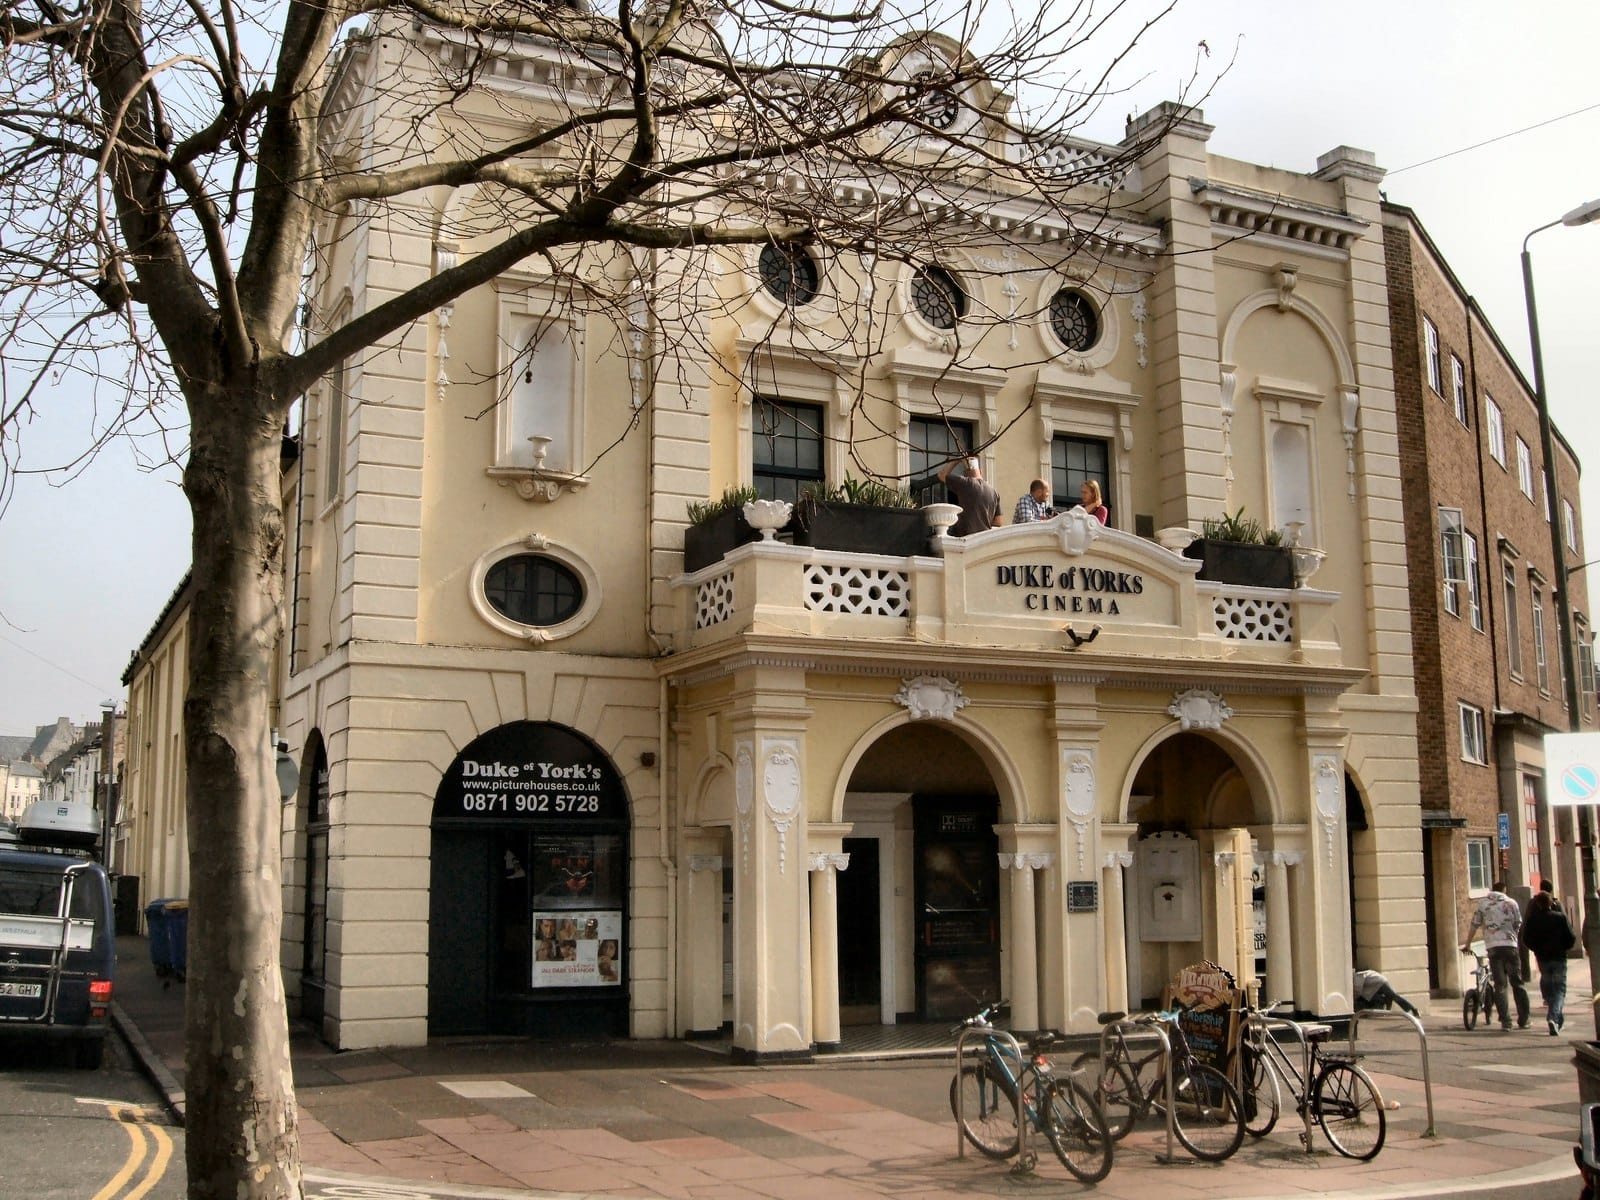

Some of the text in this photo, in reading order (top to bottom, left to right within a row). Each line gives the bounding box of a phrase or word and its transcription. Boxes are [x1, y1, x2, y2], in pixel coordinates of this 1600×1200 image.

[997, 565, 1143, 594] DUKE of YORKS
[1026, 593, 1120, 615] CINEMA
[462, 760, 602, 779] Duke of York's
[462, 780, 601, 792] www.picturehouses.co.uk
[463, 793, 599, 812] 0871 902 5728
[19, 985, 39, 995] GHY
